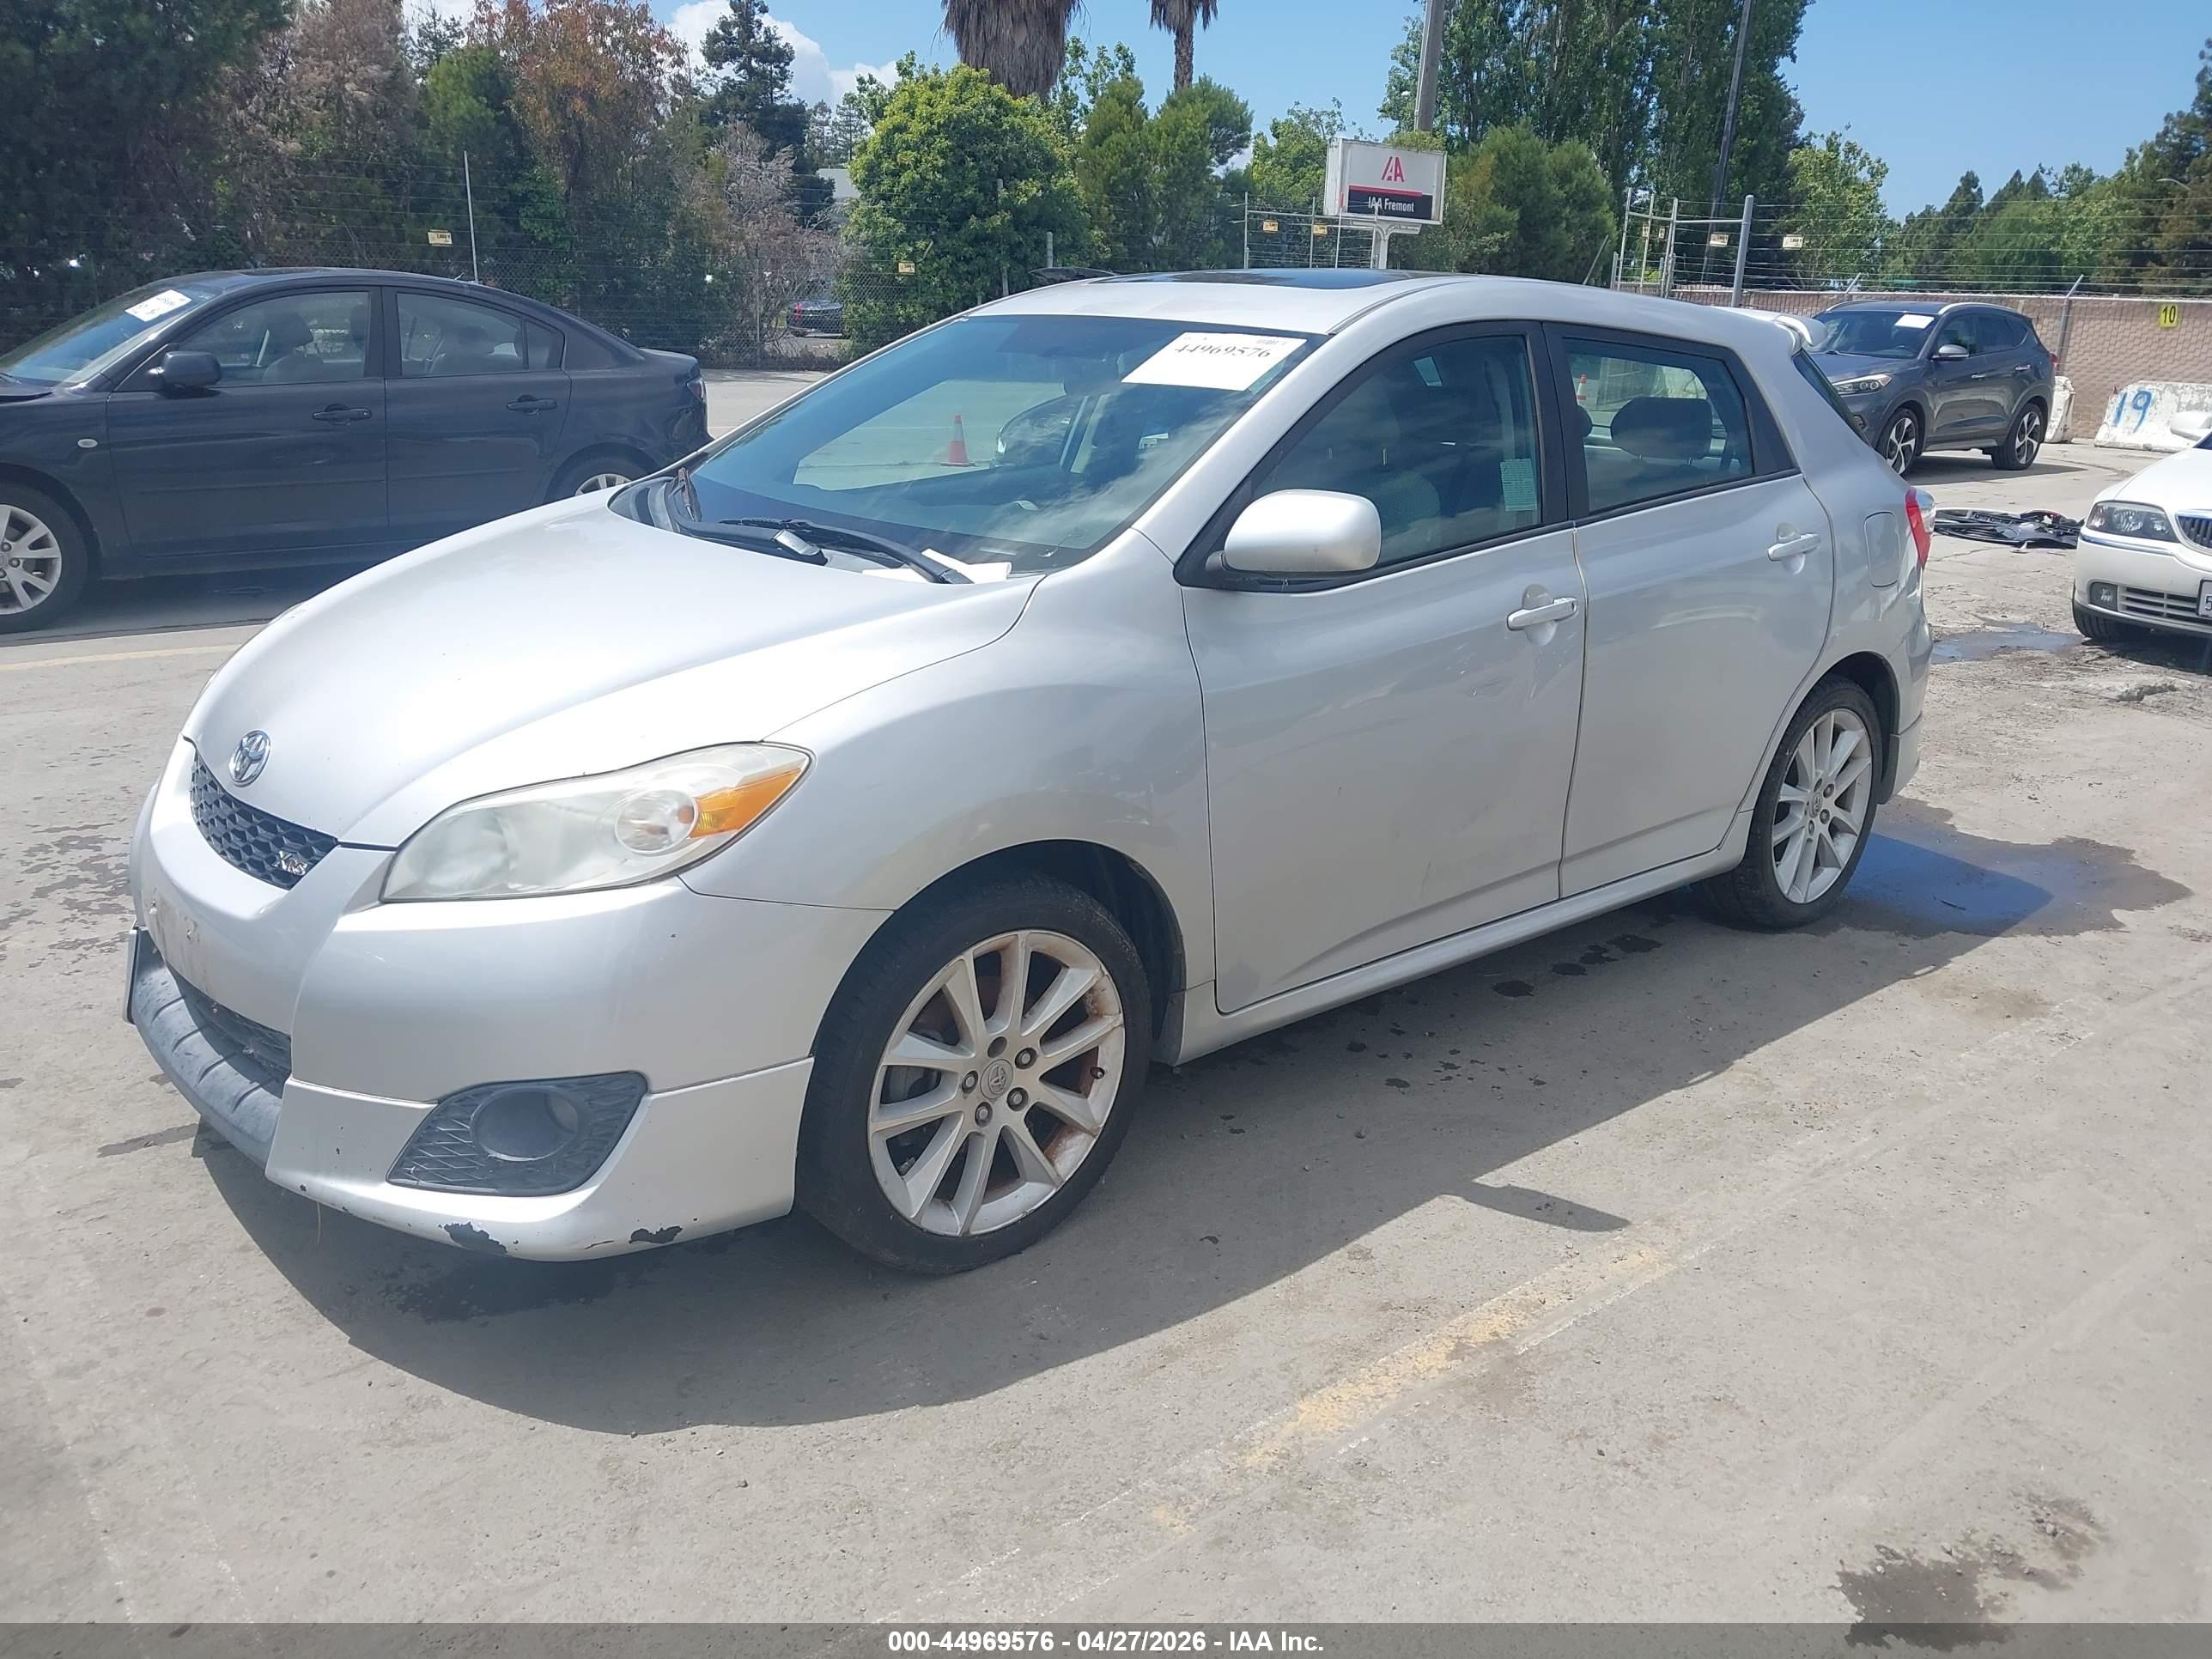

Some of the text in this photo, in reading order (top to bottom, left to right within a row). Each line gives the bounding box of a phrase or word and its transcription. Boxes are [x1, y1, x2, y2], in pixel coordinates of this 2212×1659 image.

[1368, 196, 1415, 213] IAA Fremont
[2162, 305, 2177, 324] 10
[2113, 390, 2153, 434] 19
